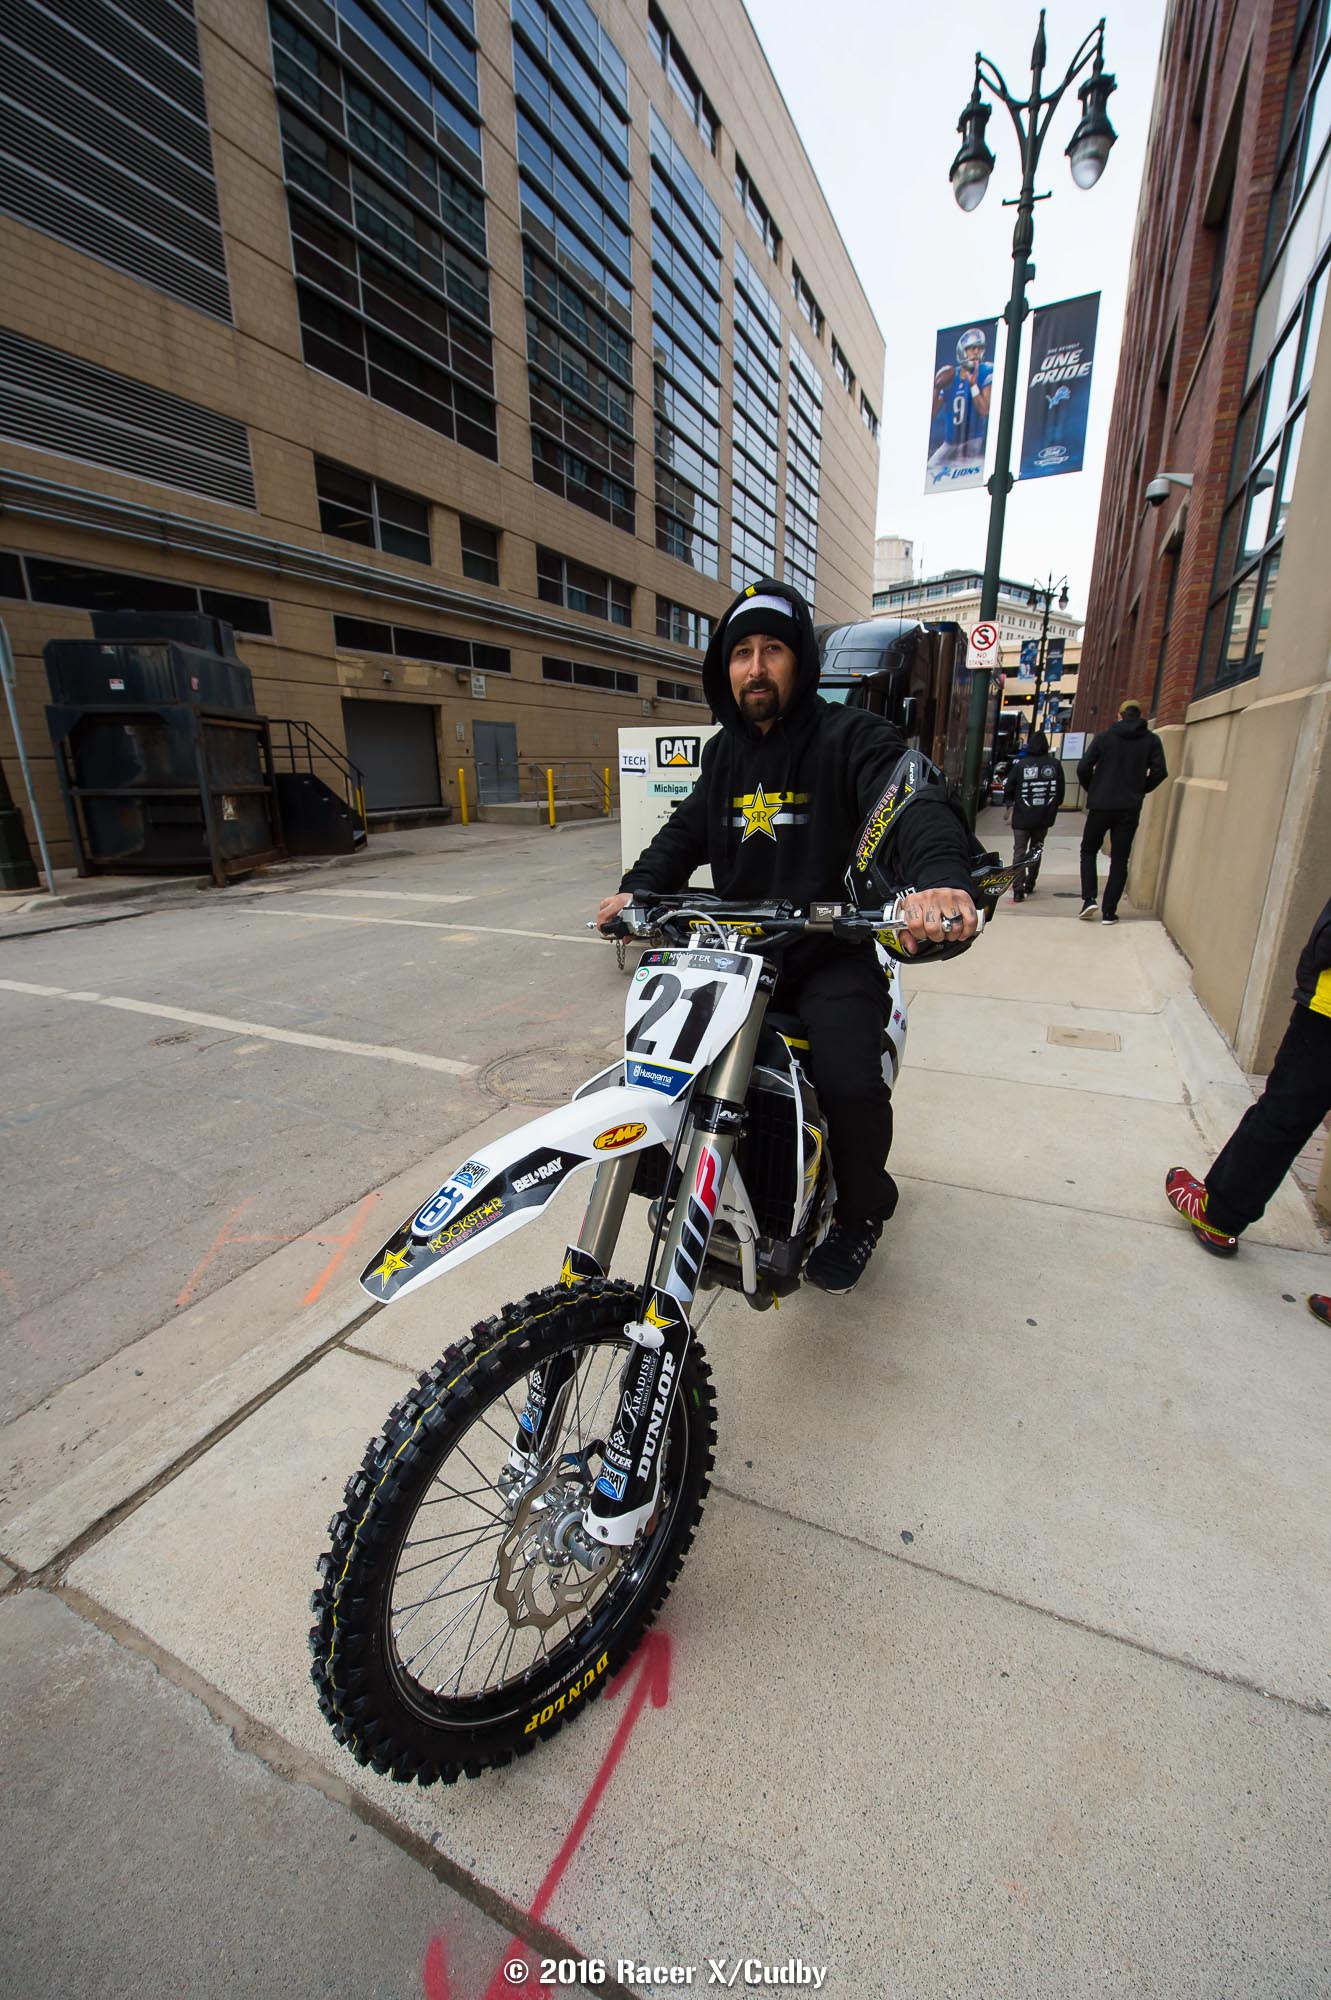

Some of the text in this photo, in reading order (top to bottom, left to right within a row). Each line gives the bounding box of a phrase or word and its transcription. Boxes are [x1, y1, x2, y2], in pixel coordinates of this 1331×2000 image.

[1040, 349, 1083, 371] ONE
[1029, 361, 1092, 387] PRIDE
[953, 396, 965, 424] 9
[623, 756, 646, 765] TECH
[660, 739, 696, 765] CAT
[654, 784, 688, 794] Michigan
[626, 973, 728, 1064] 21
[640, 1069, 672, 1083] Husqvarna
[597, 1123, 645, 1149] FMF
[440, 1210, 502, 1254] ENERGY DRINK
[637, 1351, 676, 1482] DUNLOP
[525, 1651, 608, 1734] DUNLOP
